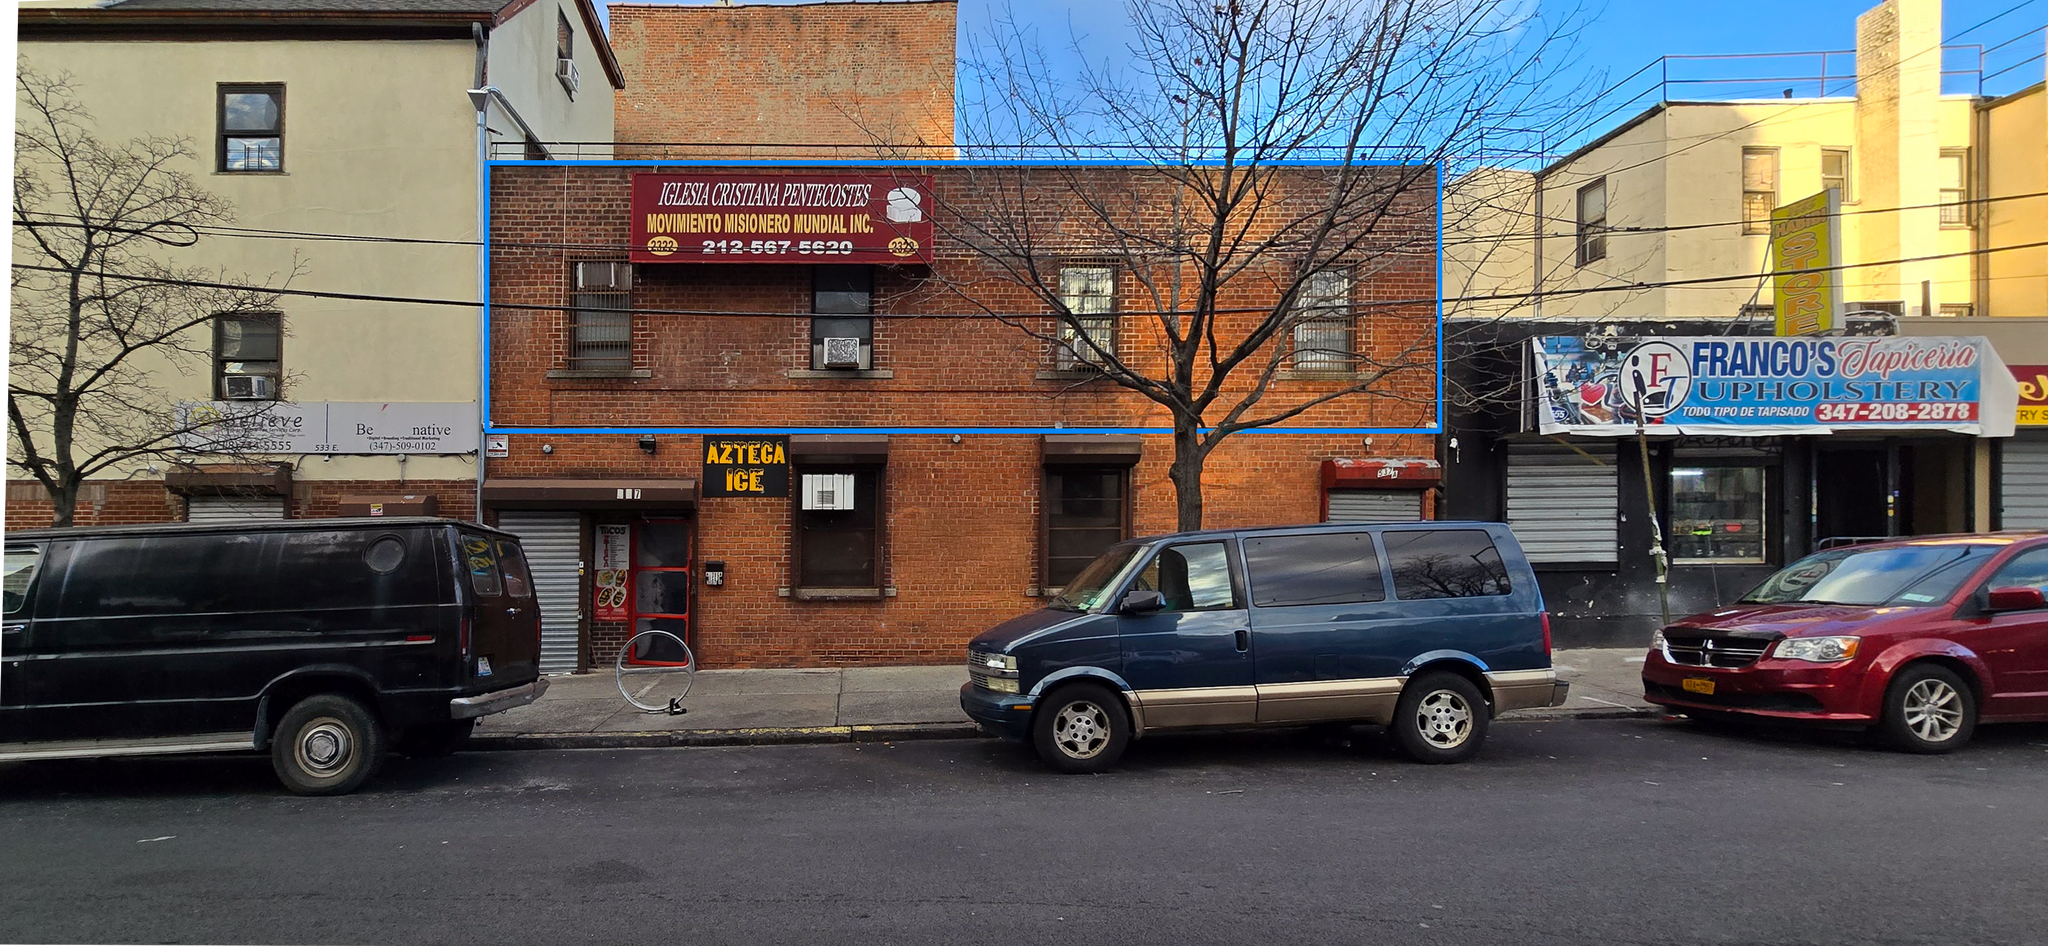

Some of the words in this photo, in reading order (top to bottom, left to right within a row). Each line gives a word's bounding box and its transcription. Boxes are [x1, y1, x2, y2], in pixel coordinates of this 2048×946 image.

[658, 182, 709, 206] IGLESIA
[711, 183, 780, 206] CRISTIANA
[780, 183, 872, 207] PENTECOSTES
[647, 213, 721, 233] MOVIMIENTO
[724, 213, 790, 233] MISIONERO
[794, 214, 847, 233] MUNDIAL
[850, 214, 874, 233] INC.
[702, 240, 853, 254] 212-567-5620
[1781, 232, 1824, 336] STORE
[1692, 340, 1836, 378] FRANCO'S
[1837, 338, 1976, 379] Tapiceria
[1699, 381, 1970, 400] UPHOLSTERY
[1683, 407, 1711, 417] TODO
[1714, 407, 1738, 417] TIPO
[1740, 407, 1756, 417] DE
[1758, 406, 1810, 417] TAPISADO
[1818, 403, 1970, 420] 347-208-2878
[356, 423, 374, 436] Be
[412, 423, 451, 436] native
[369, 441, 436, 451] (347)-509-0102
[706, 441, 786, 464] AZTECA
[726, 468, 765, 491] ICE
[599, 526, 626, 535] TACOS
